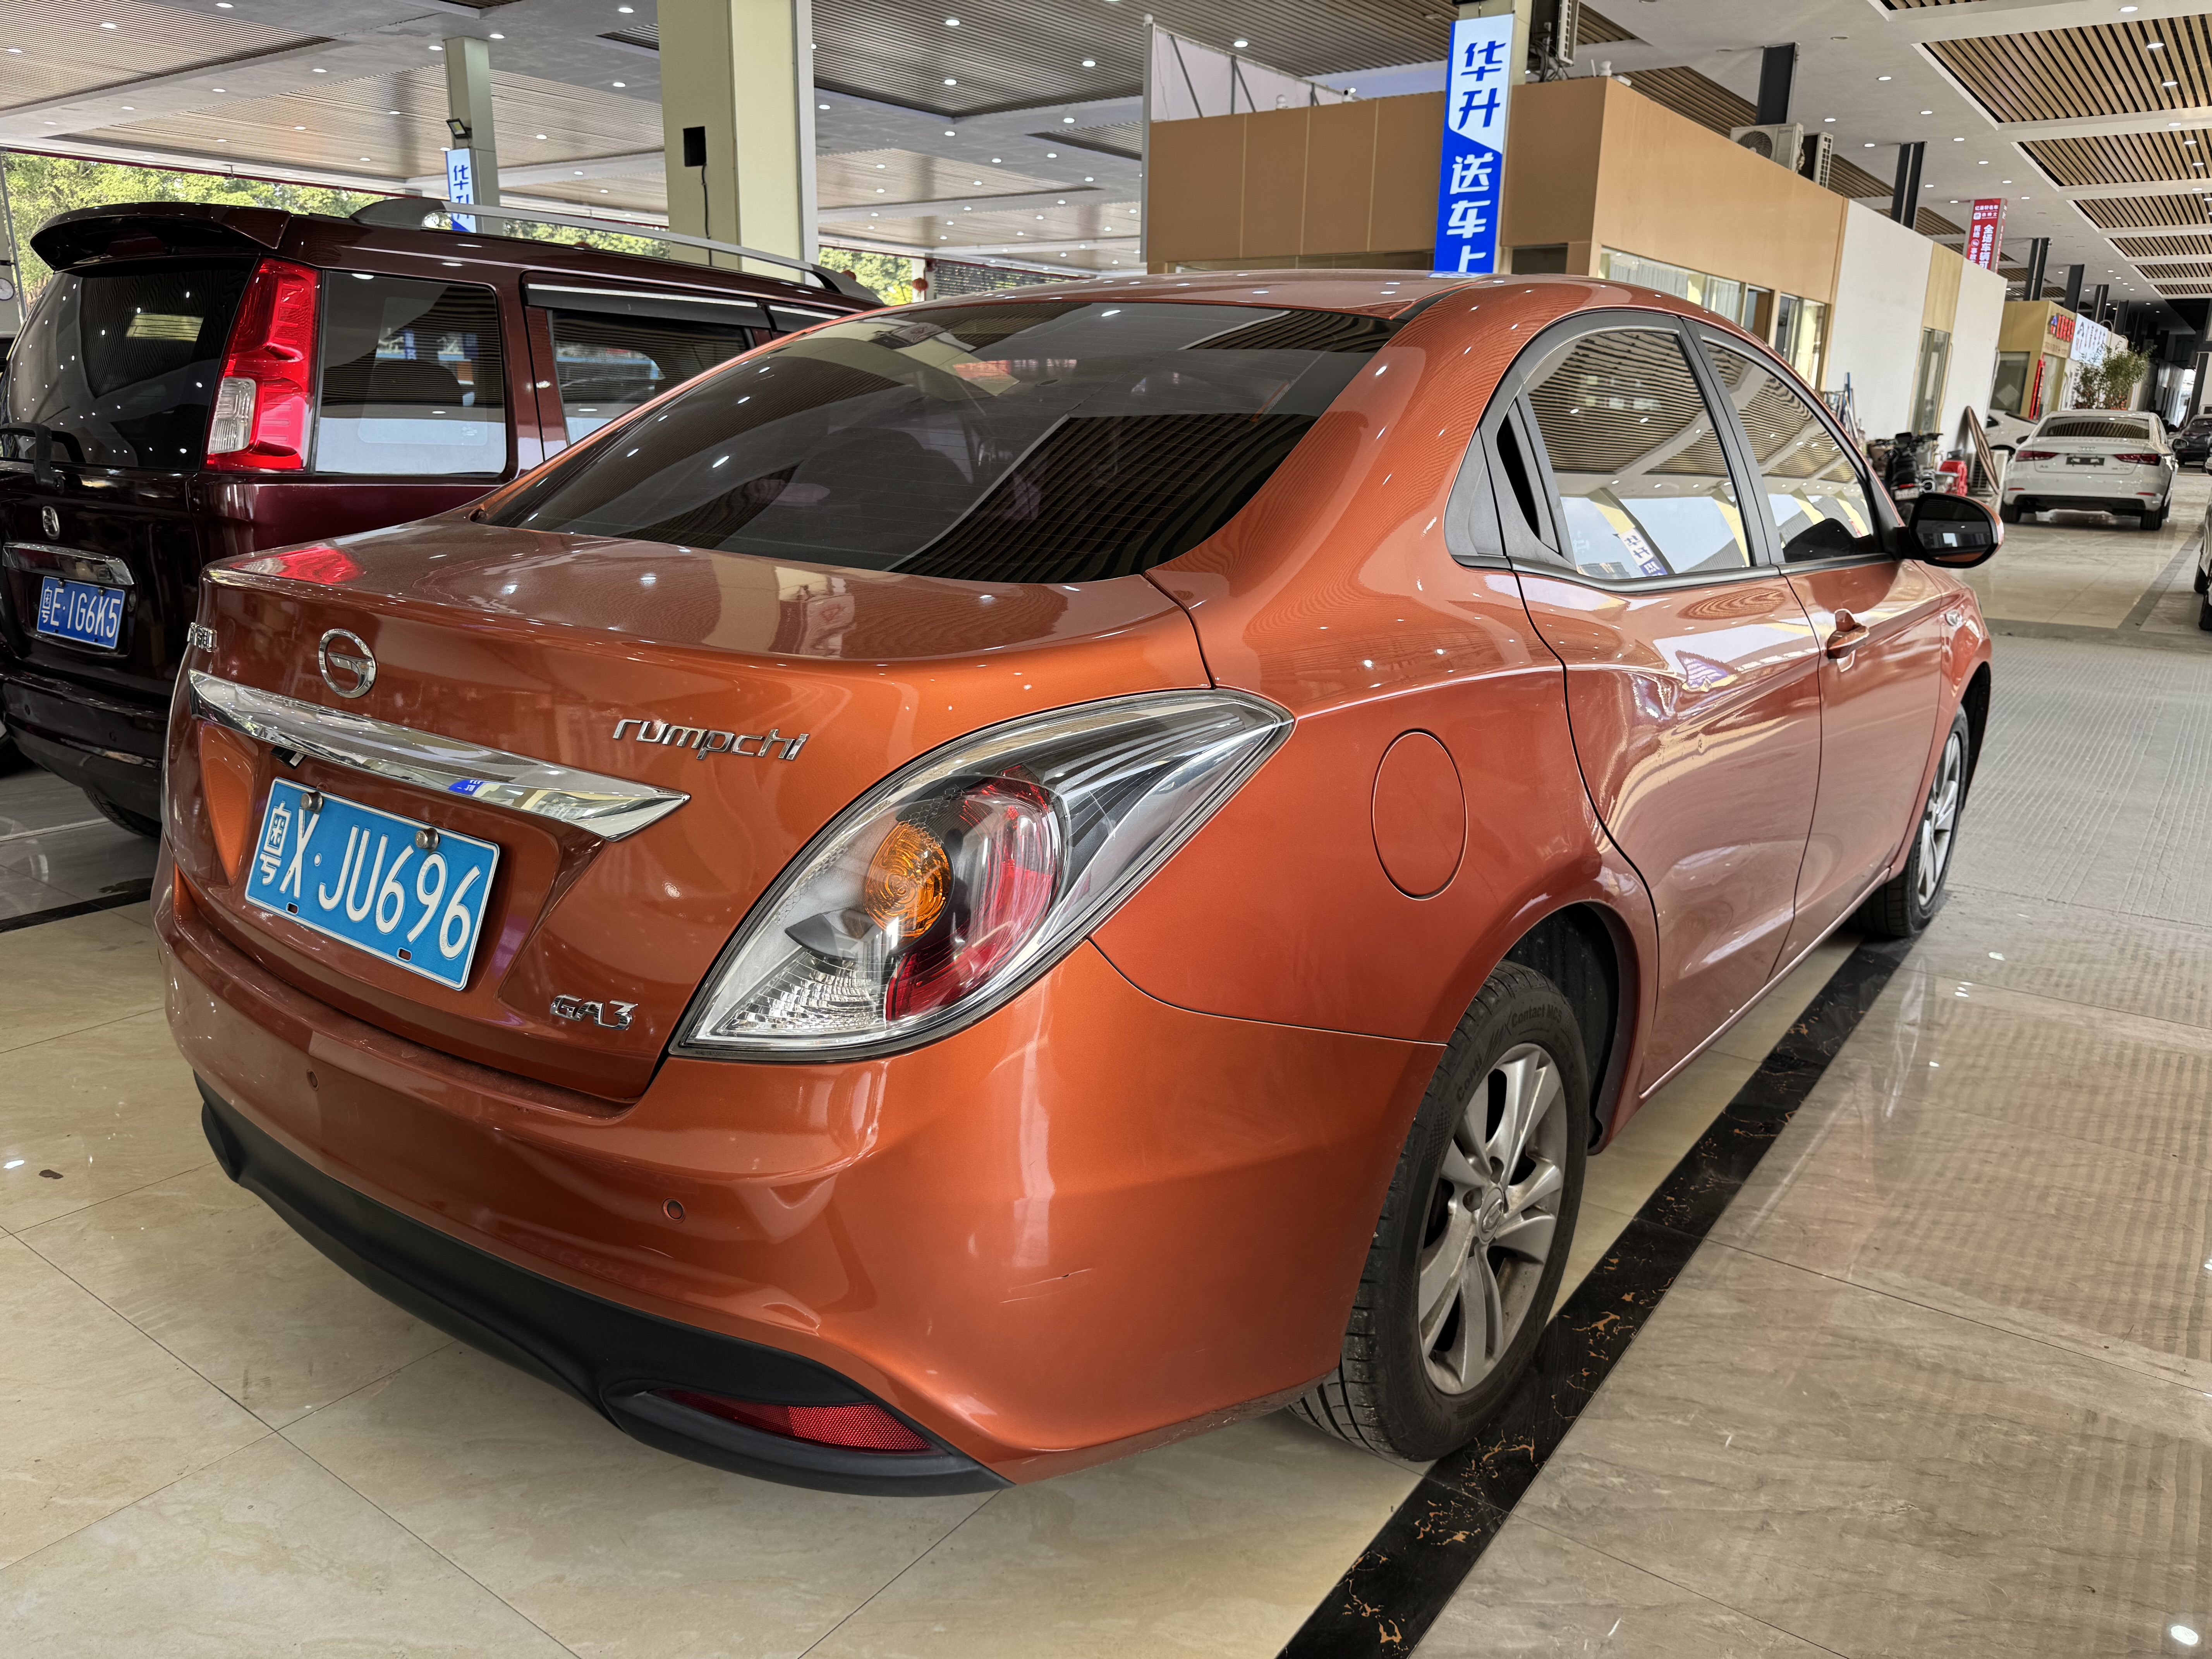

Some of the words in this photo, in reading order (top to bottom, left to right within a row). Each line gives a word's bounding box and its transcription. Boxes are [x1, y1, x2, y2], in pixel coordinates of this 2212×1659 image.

[1457, 40, 1507, 131] 华升
[612, 718, 810, 761] rumpchi
[259, 800, 481, 959] 粤X·JU696
[550, 994, 639, 1030] GA3
